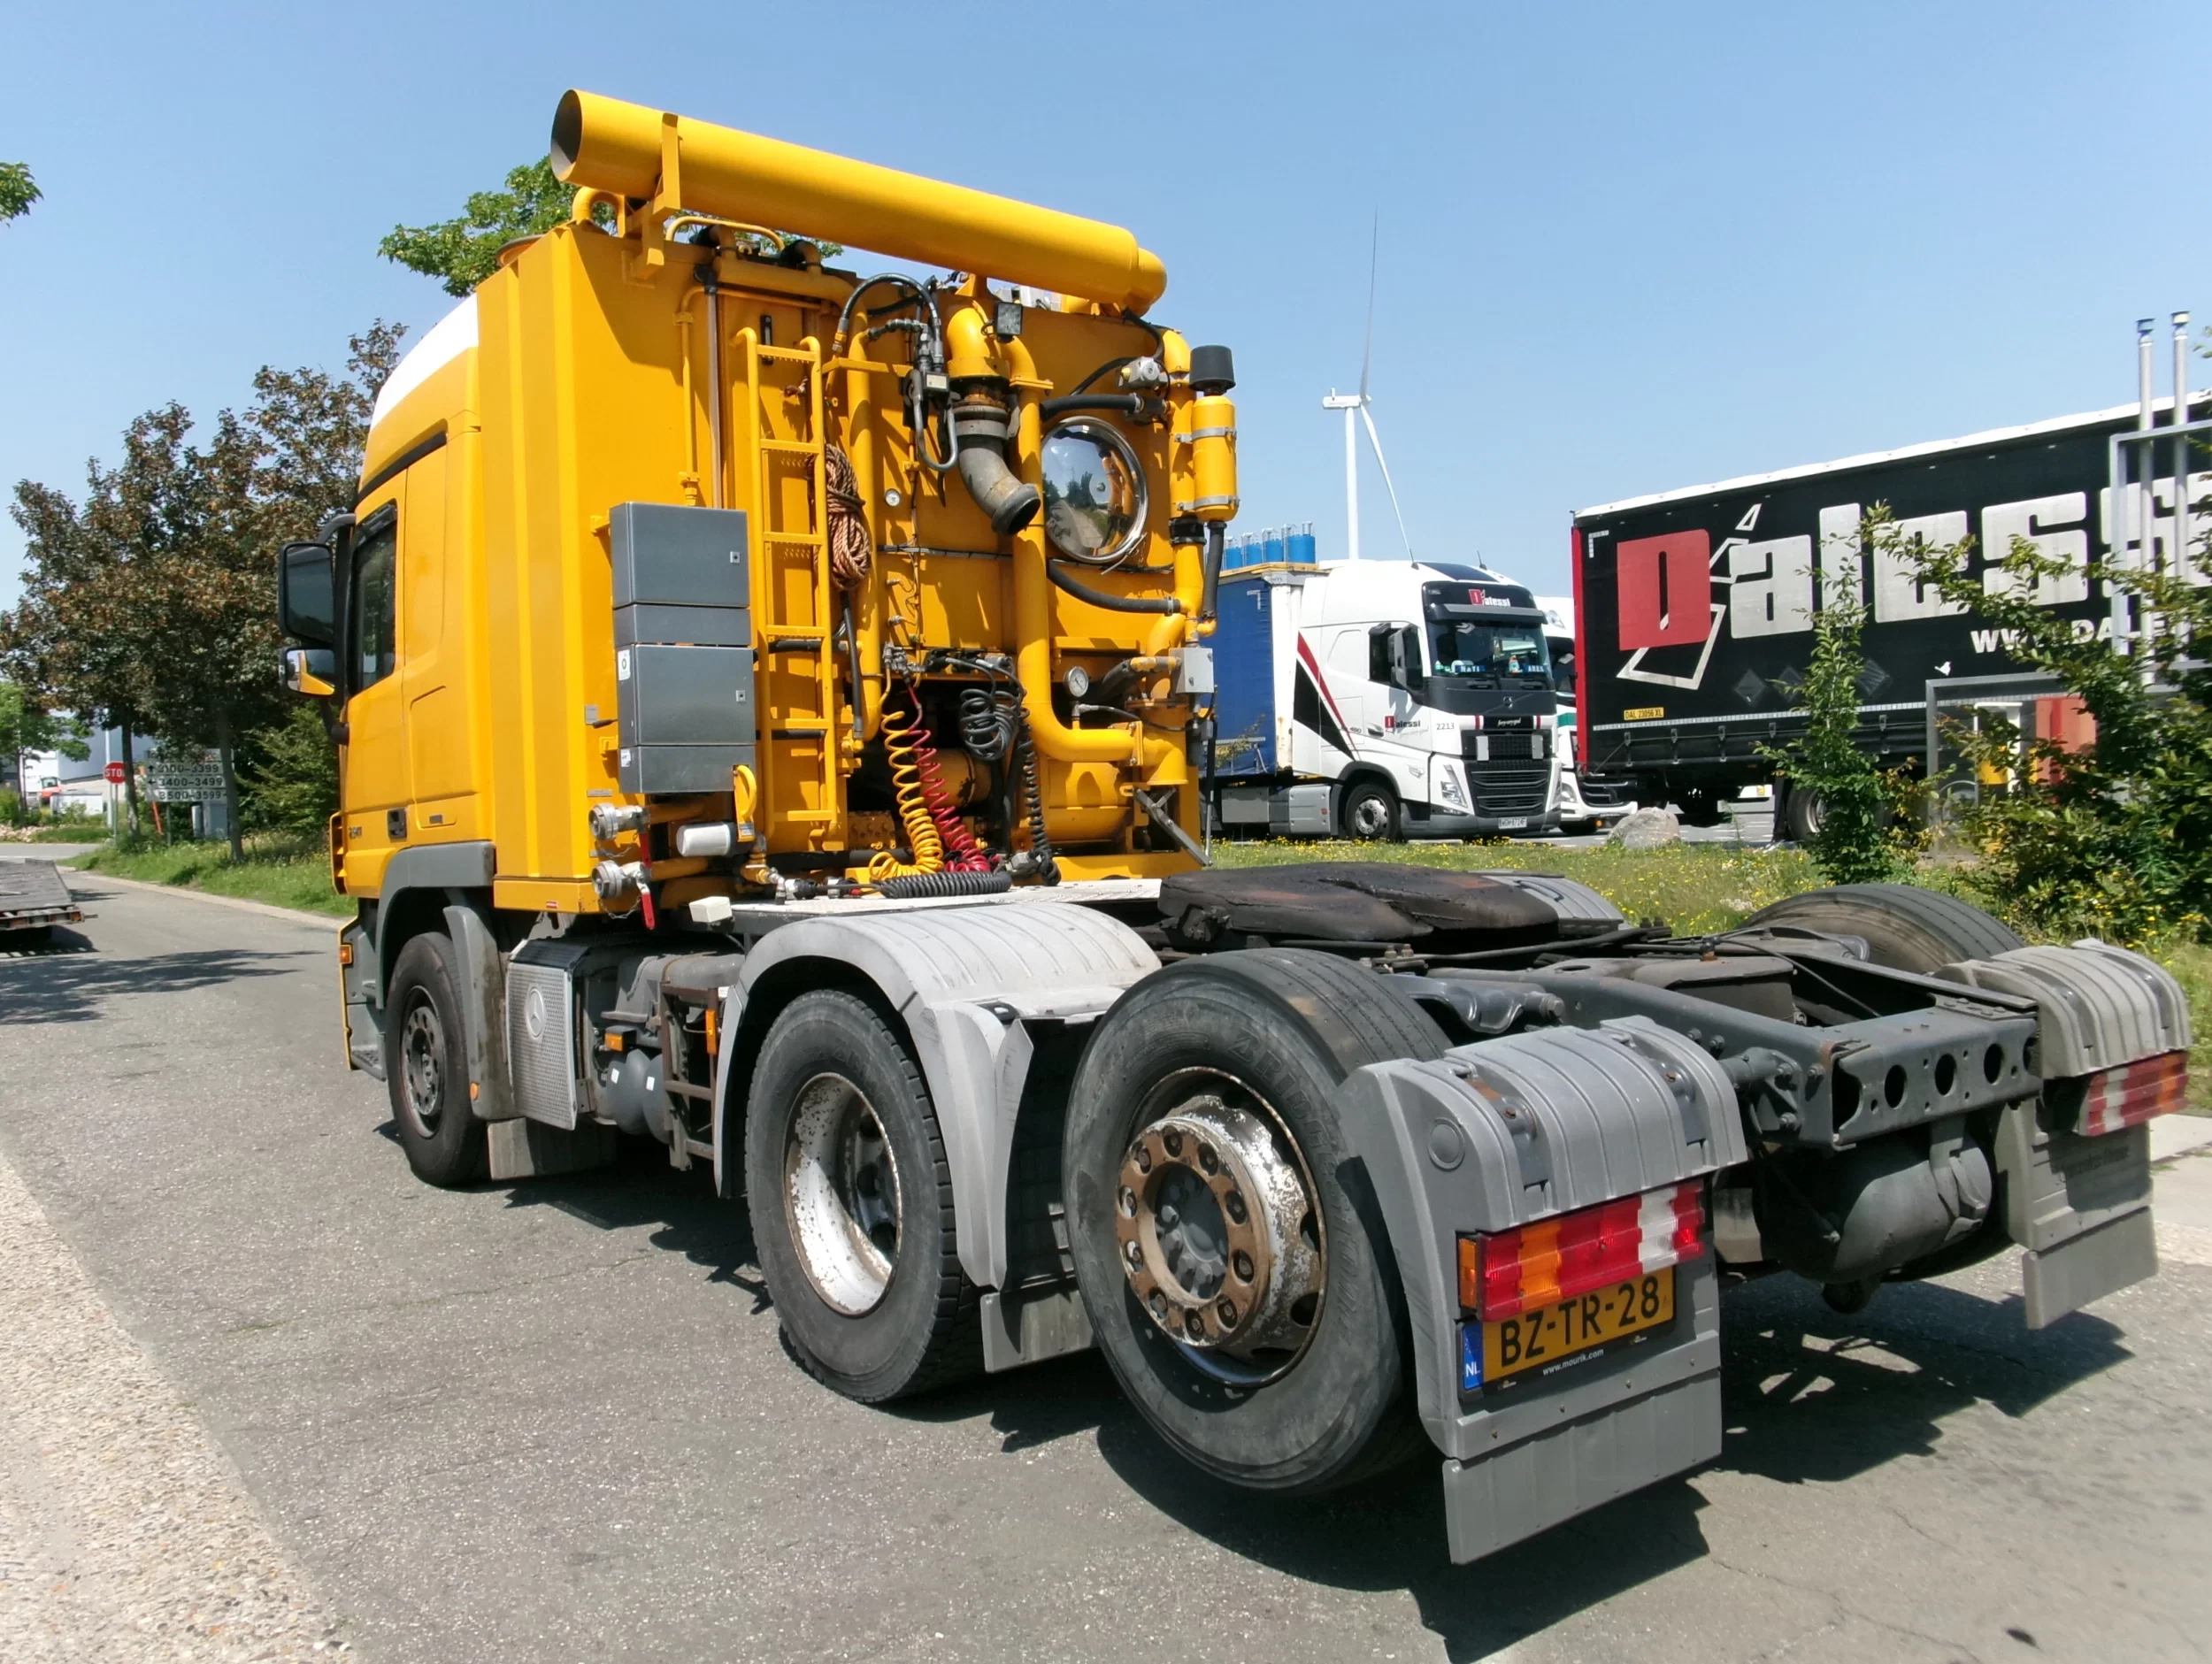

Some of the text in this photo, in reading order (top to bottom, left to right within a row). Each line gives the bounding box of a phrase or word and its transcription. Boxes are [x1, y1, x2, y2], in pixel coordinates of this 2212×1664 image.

[1436, 722, 1455, 731] 2213
[104, 768, 125, 778] STO
[158, 778, 223, 786] 3400-3499
[1501, 1276, 1660, 1368] BZ-TR-28
[1542, 1348, 1605, 1376] www.mourik.com
[1465, 1362, 1481, 1377] NL
